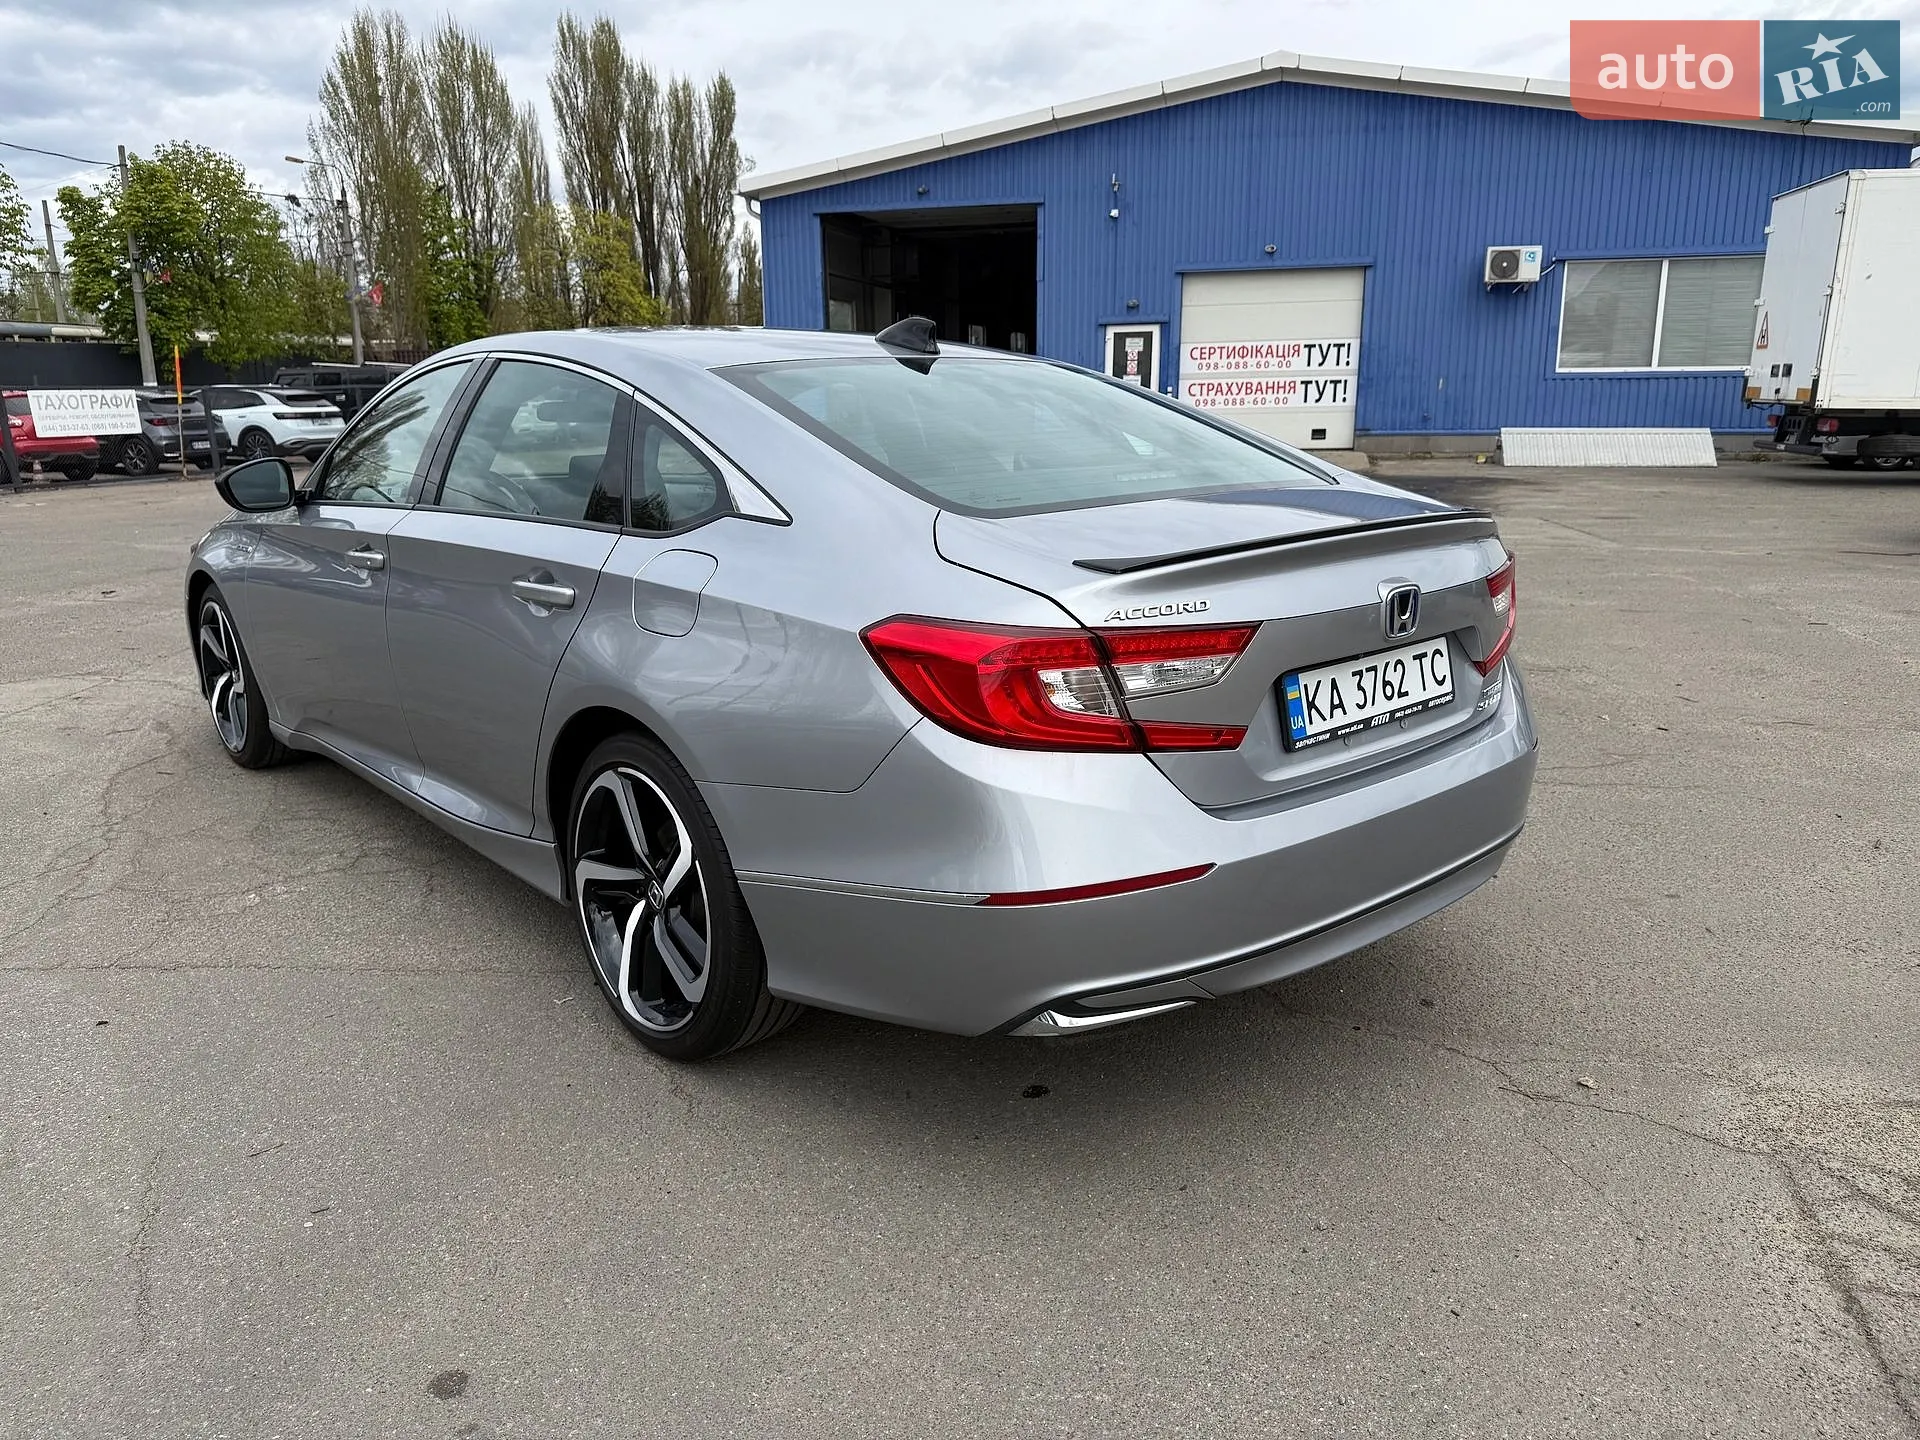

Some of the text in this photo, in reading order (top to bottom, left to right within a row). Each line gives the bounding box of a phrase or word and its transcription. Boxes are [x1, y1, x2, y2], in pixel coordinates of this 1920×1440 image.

[1190, 343, 1351, 367] СЕРТИФІКАЦІЯ ТУТ!
[1198, 360, 1292, 371] 098-088-60-00
[1188, 379, 1348, 404] СТРАХУВАННЯ ТУТ!
[32, 393, 135, 410] ТАХОГРАФИ
[1195, 396, 1288, 408] 098-088-60-00
[1104, 600, 1211, 622] ACCORD
[1303, 648, 1447, 725] KA 3762 TC
[1291, 715, 1305, 730] UA
